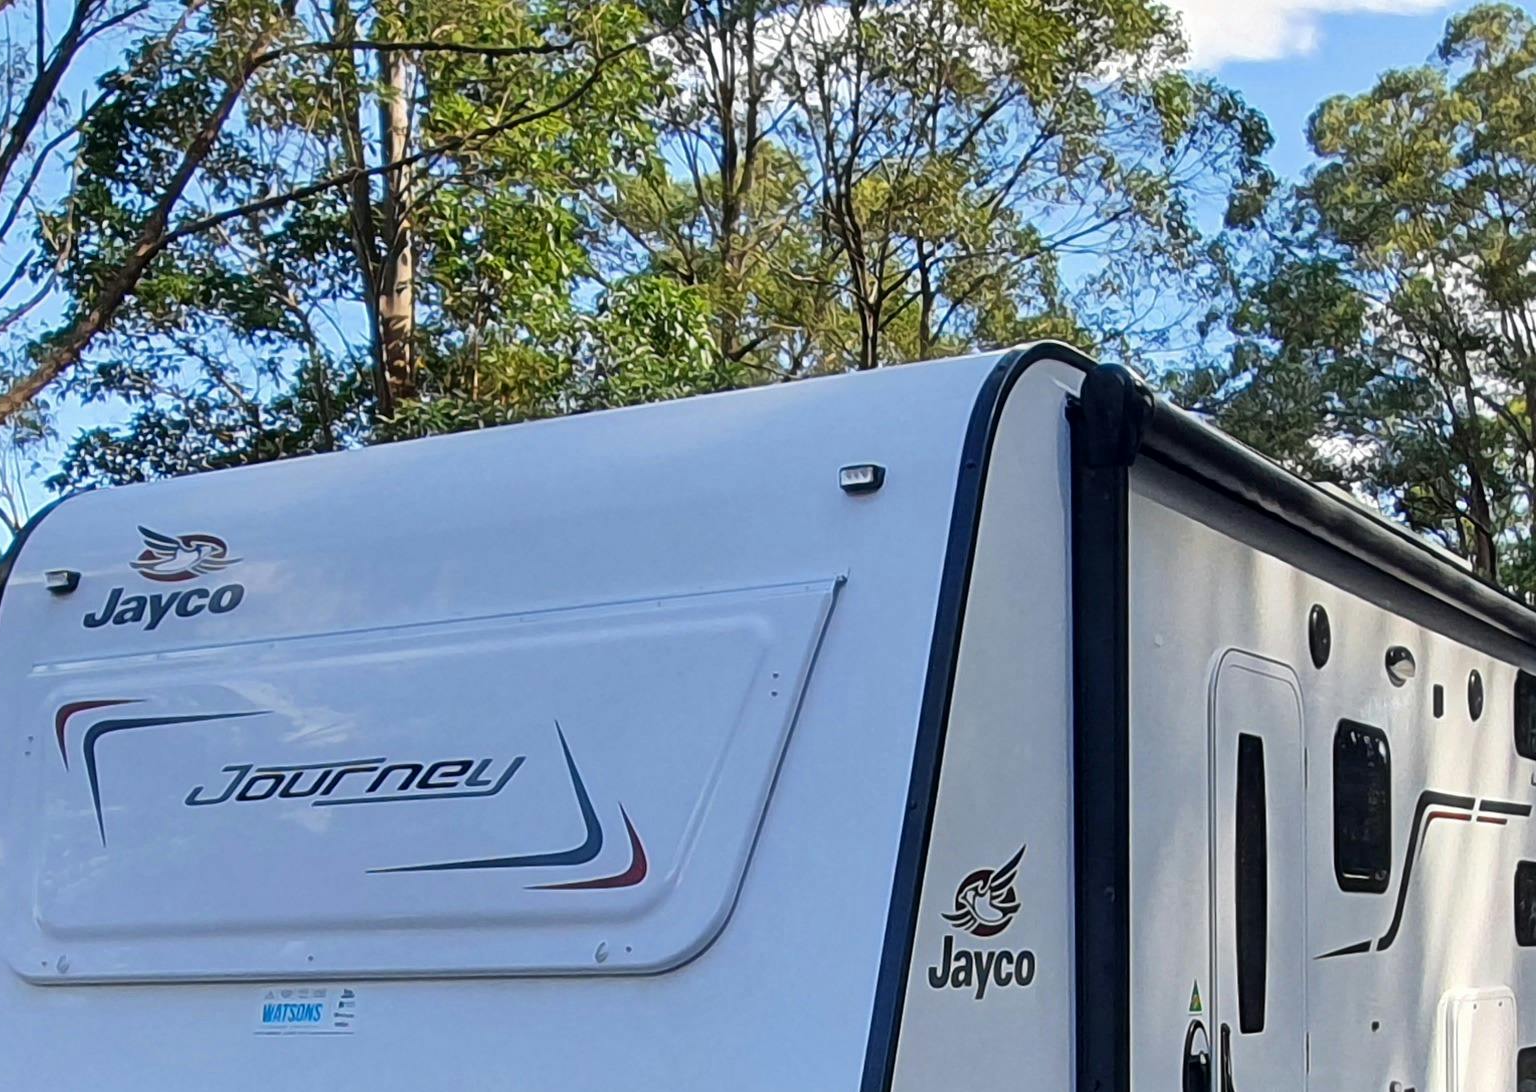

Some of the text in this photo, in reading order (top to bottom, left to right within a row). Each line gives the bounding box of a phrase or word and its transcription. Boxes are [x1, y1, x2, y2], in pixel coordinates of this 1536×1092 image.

[83, 583, 245, 631] Jayco
[184, 755, 527, 807] Journey
[928, 935, 1036, 1000] Jayco
[262, 1003, 323, 1023] WATSONS
